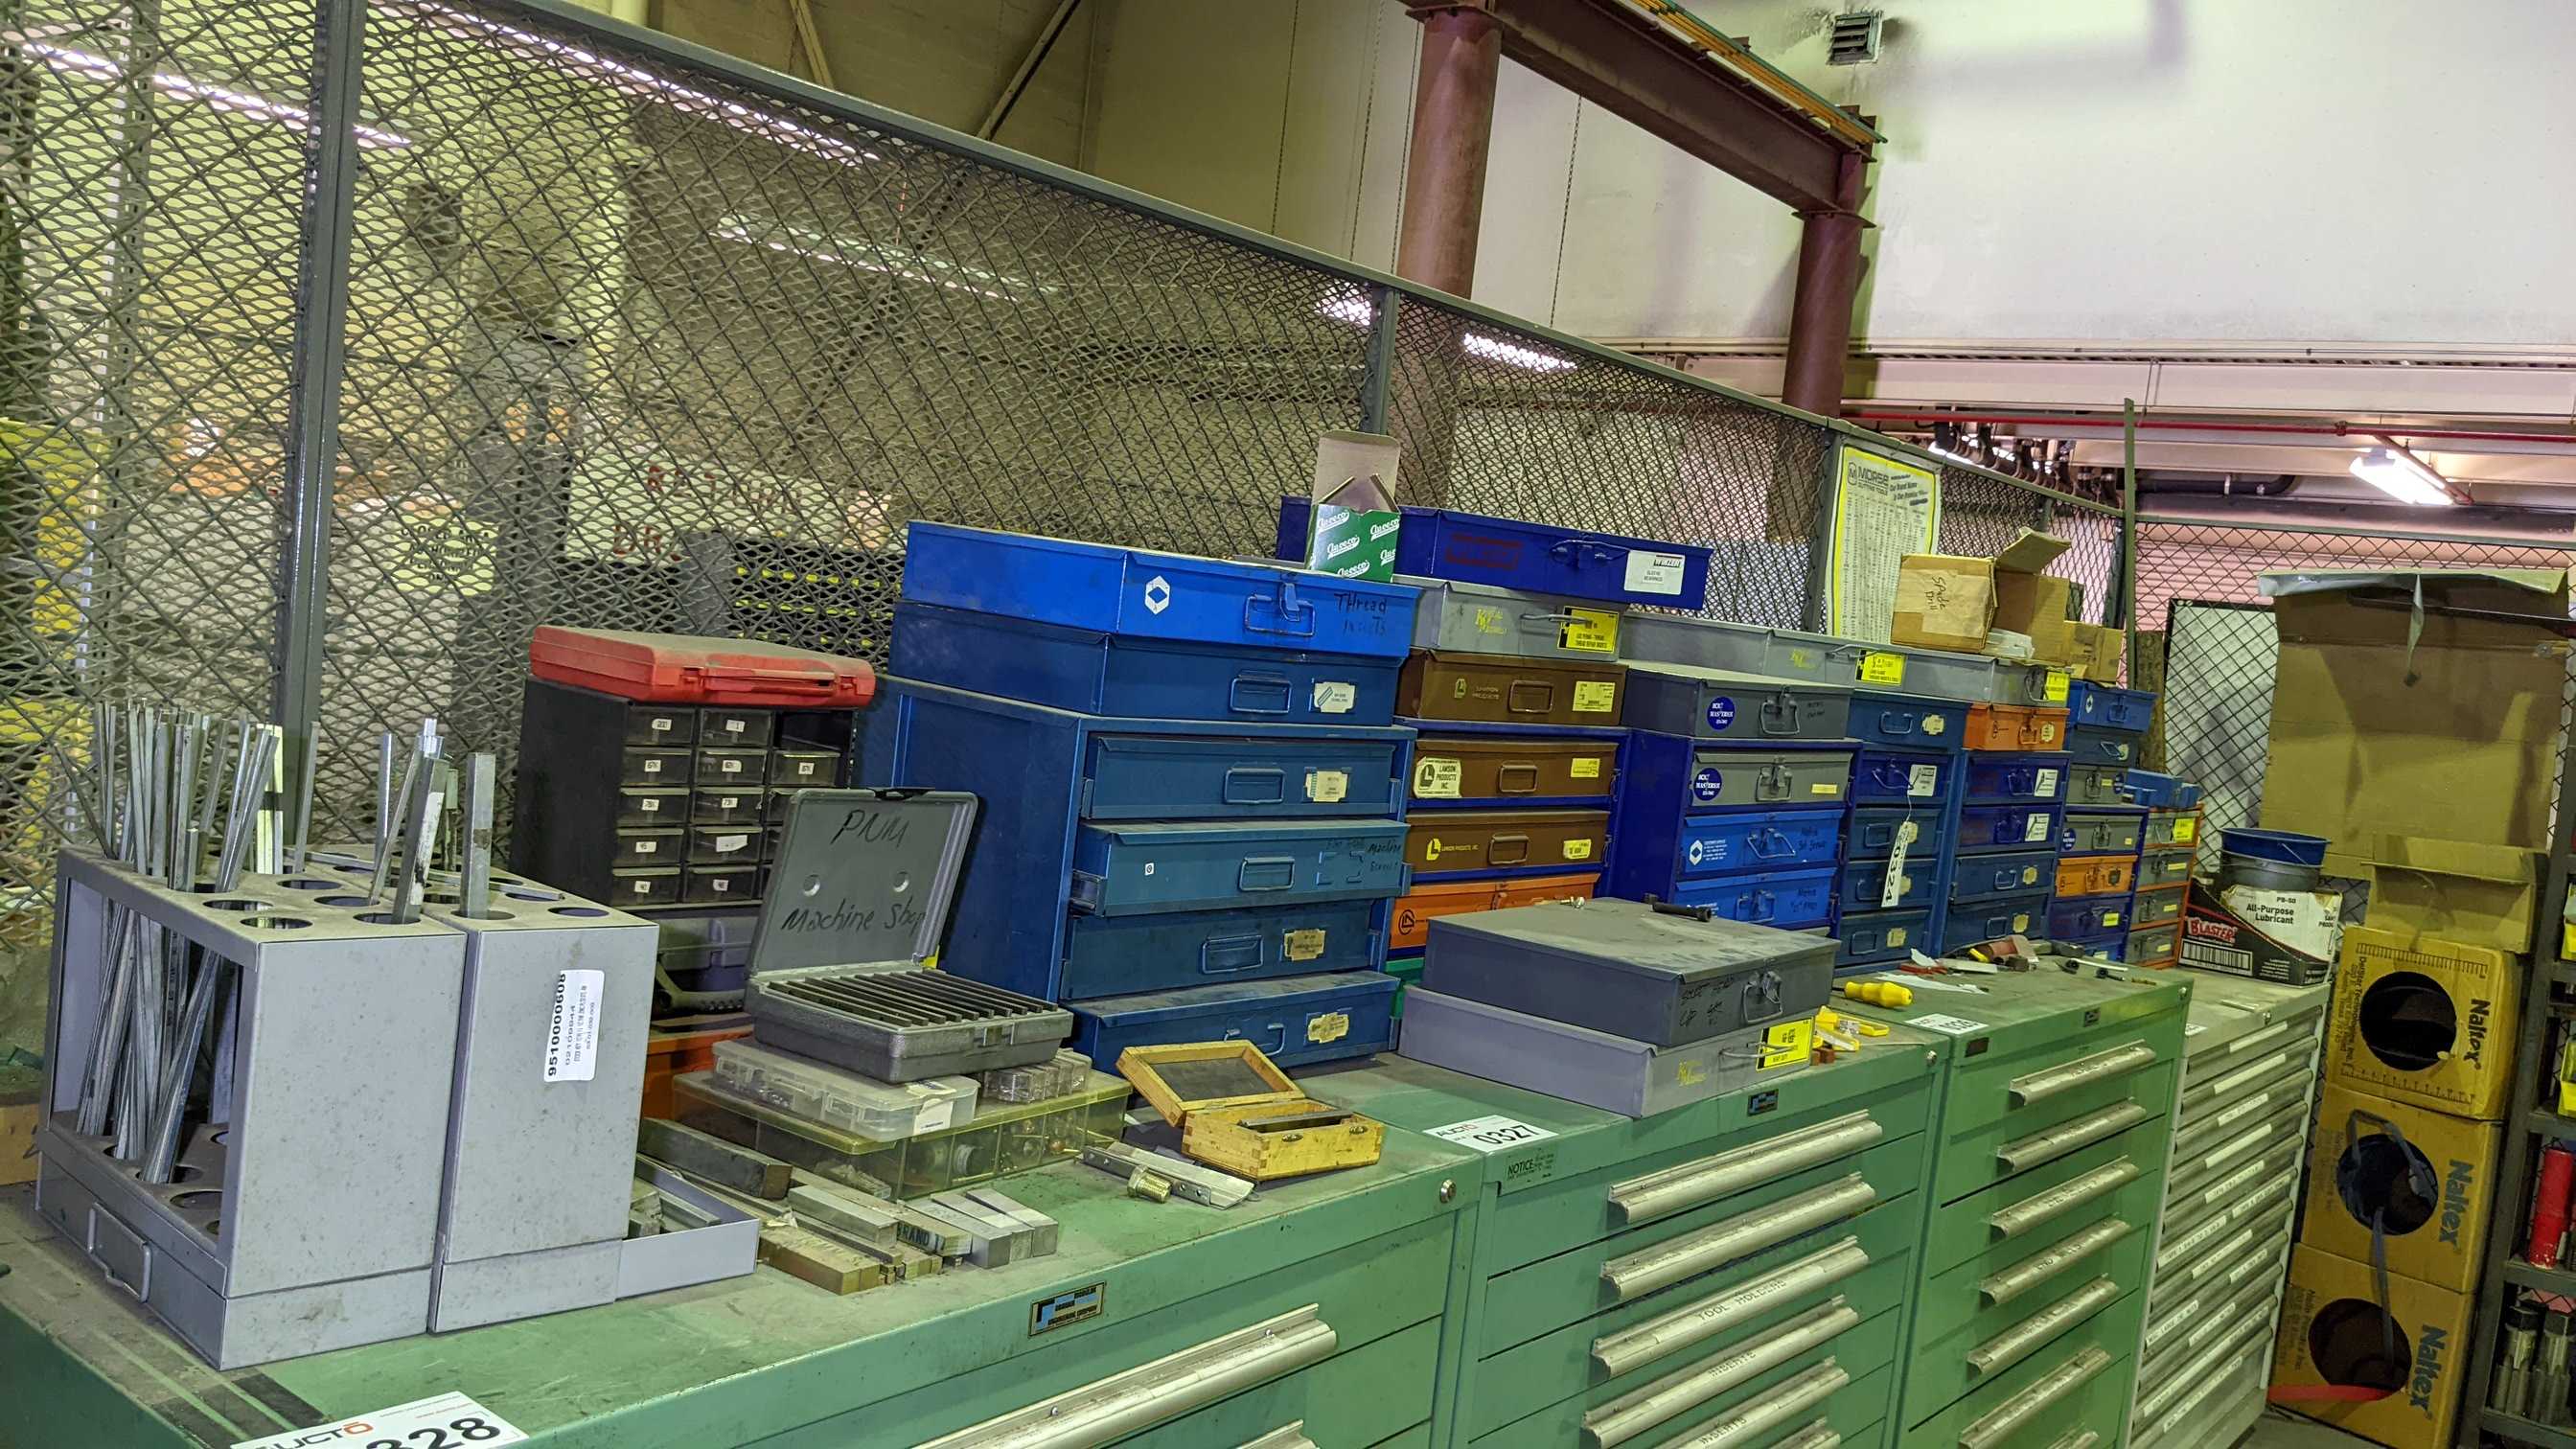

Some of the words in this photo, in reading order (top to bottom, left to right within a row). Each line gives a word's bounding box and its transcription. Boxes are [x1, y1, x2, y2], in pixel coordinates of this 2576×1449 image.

[2246, 904, 2294, 916] All-Purpose
[2255, 913, 2294, 925] Lubricant
[1473, 1124, 1540, 1145] 0327
[1506, 1158, 1533, 1177] NOTICE
[1696, 1303, 1731, 1321] TOOL
